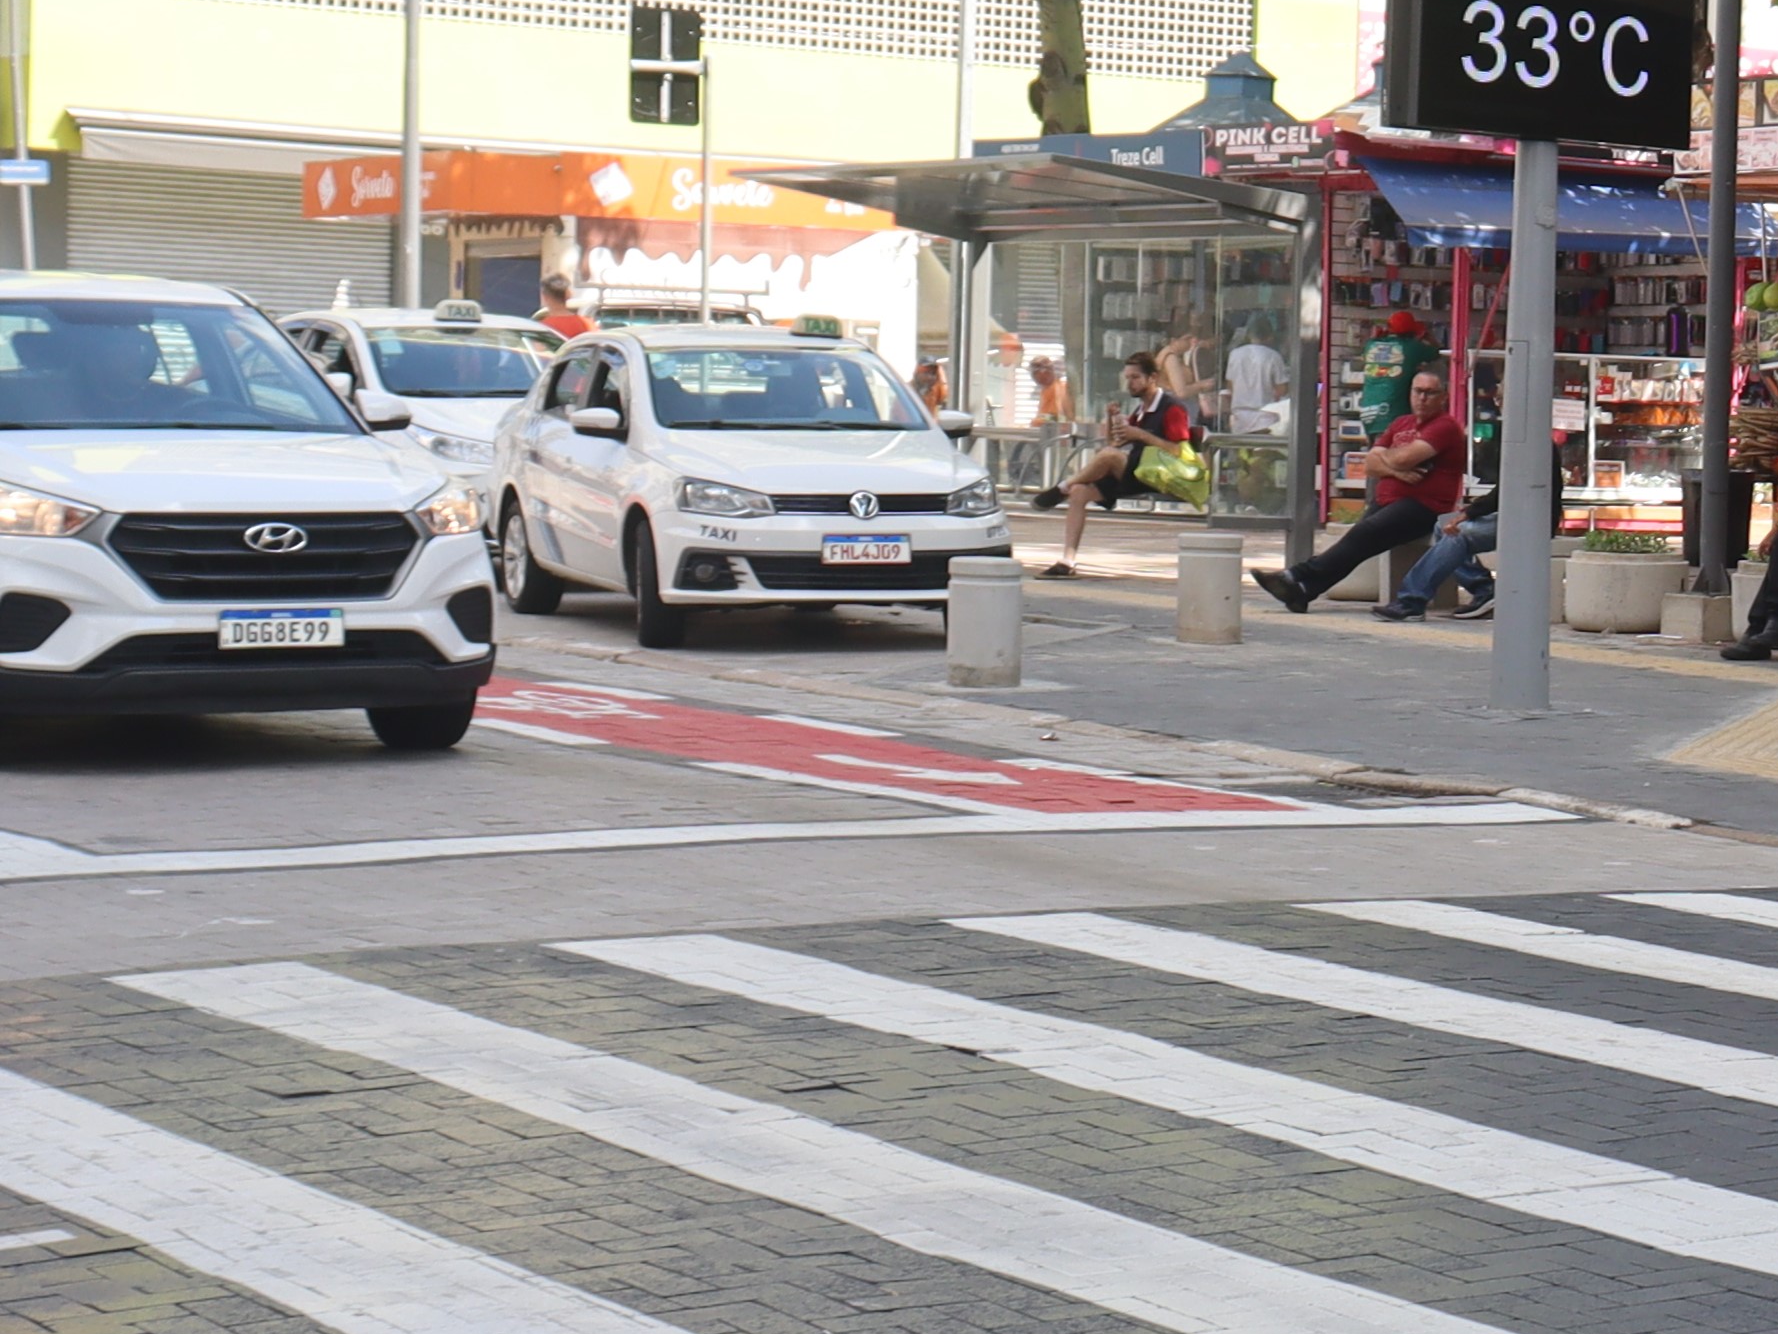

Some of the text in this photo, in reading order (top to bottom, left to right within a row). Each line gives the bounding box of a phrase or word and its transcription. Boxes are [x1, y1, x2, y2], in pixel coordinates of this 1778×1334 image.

[1215, 125, 1324, 147] PINK CELL
[1110, 145, 1164, 167] Treze Cell
[448, 304, 477, 318] TAXI
[805, 317, 838, 334] TAXI
[700, 524, 738, 543] TAXI
[232, 621, 330, 644] DGG8E99
